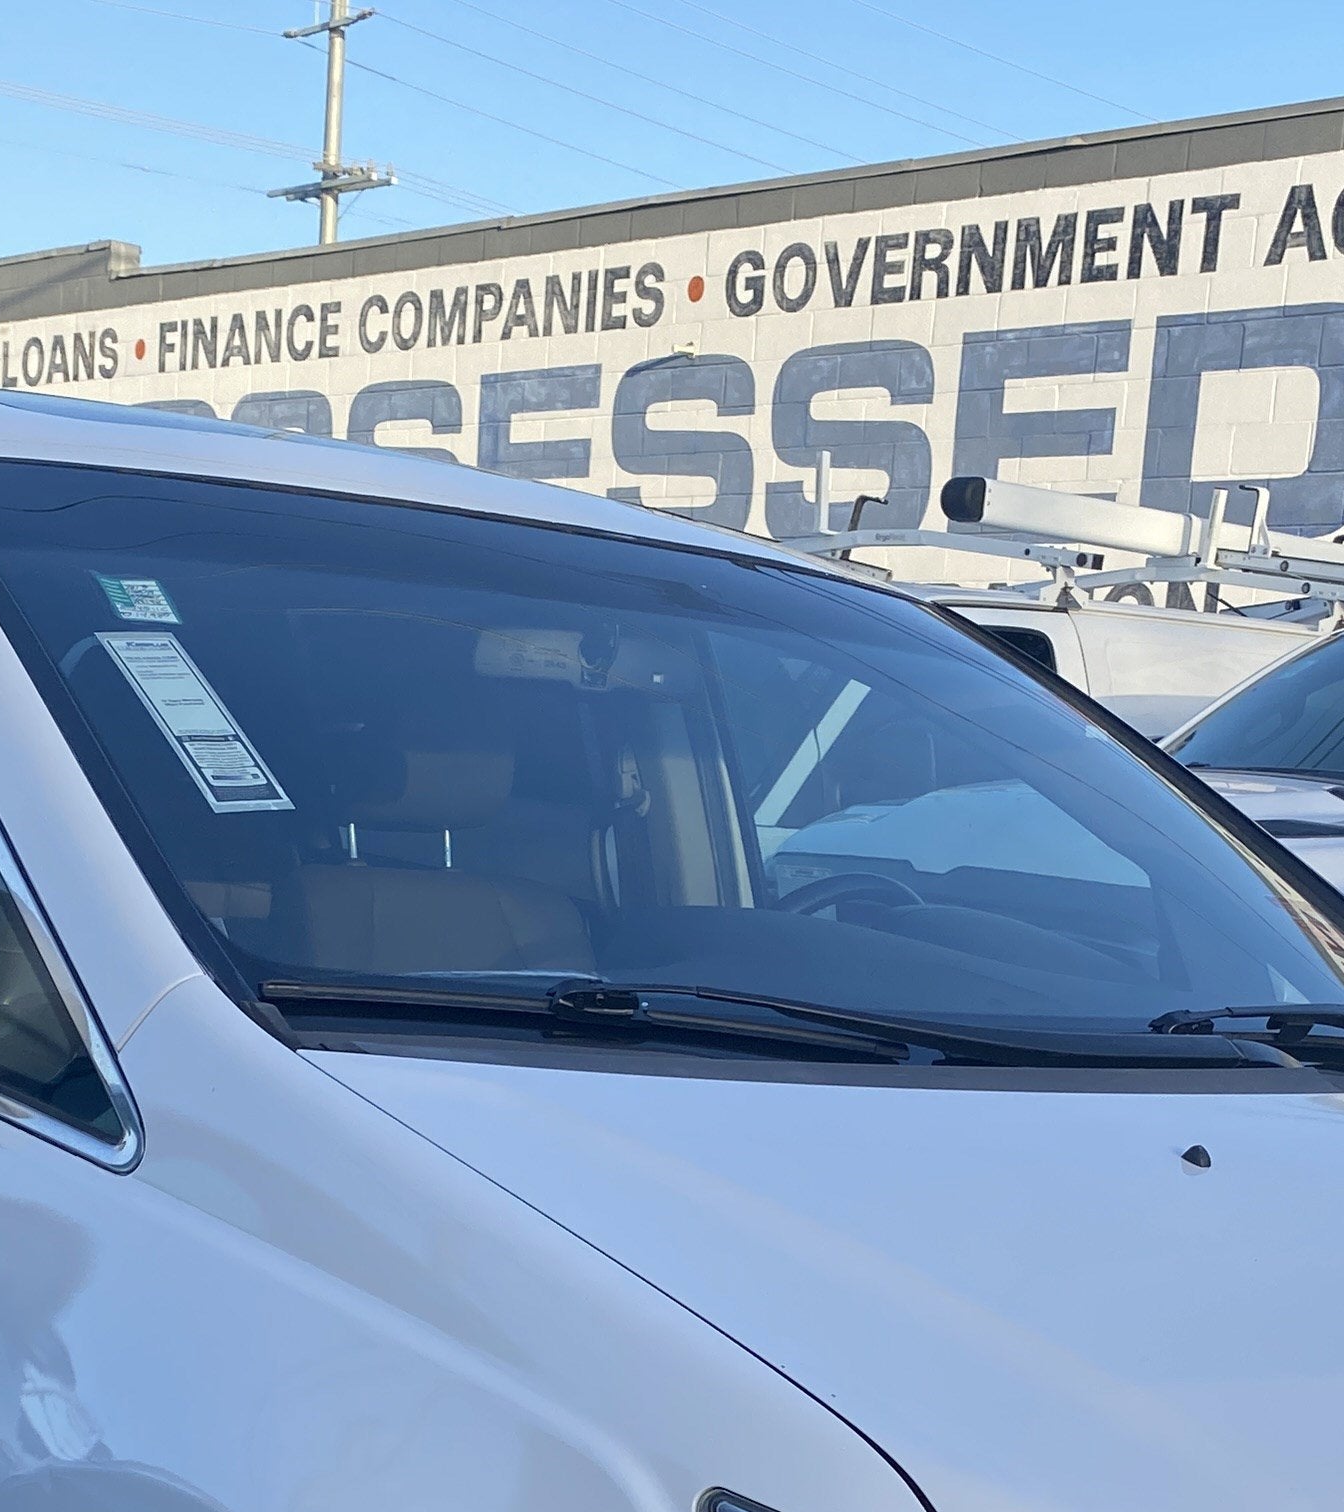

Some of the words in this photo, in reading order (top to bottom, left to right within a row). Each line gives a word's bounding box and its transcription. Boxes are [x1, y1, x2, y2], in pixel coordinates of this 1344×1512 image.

[2, 328, 118, 388] LOANS
[158, 300, 342, 373] FINANCE
[359, 261, 666, 354] COMPANIES
[725, 192, 1241, 317] GOVERNMENT
